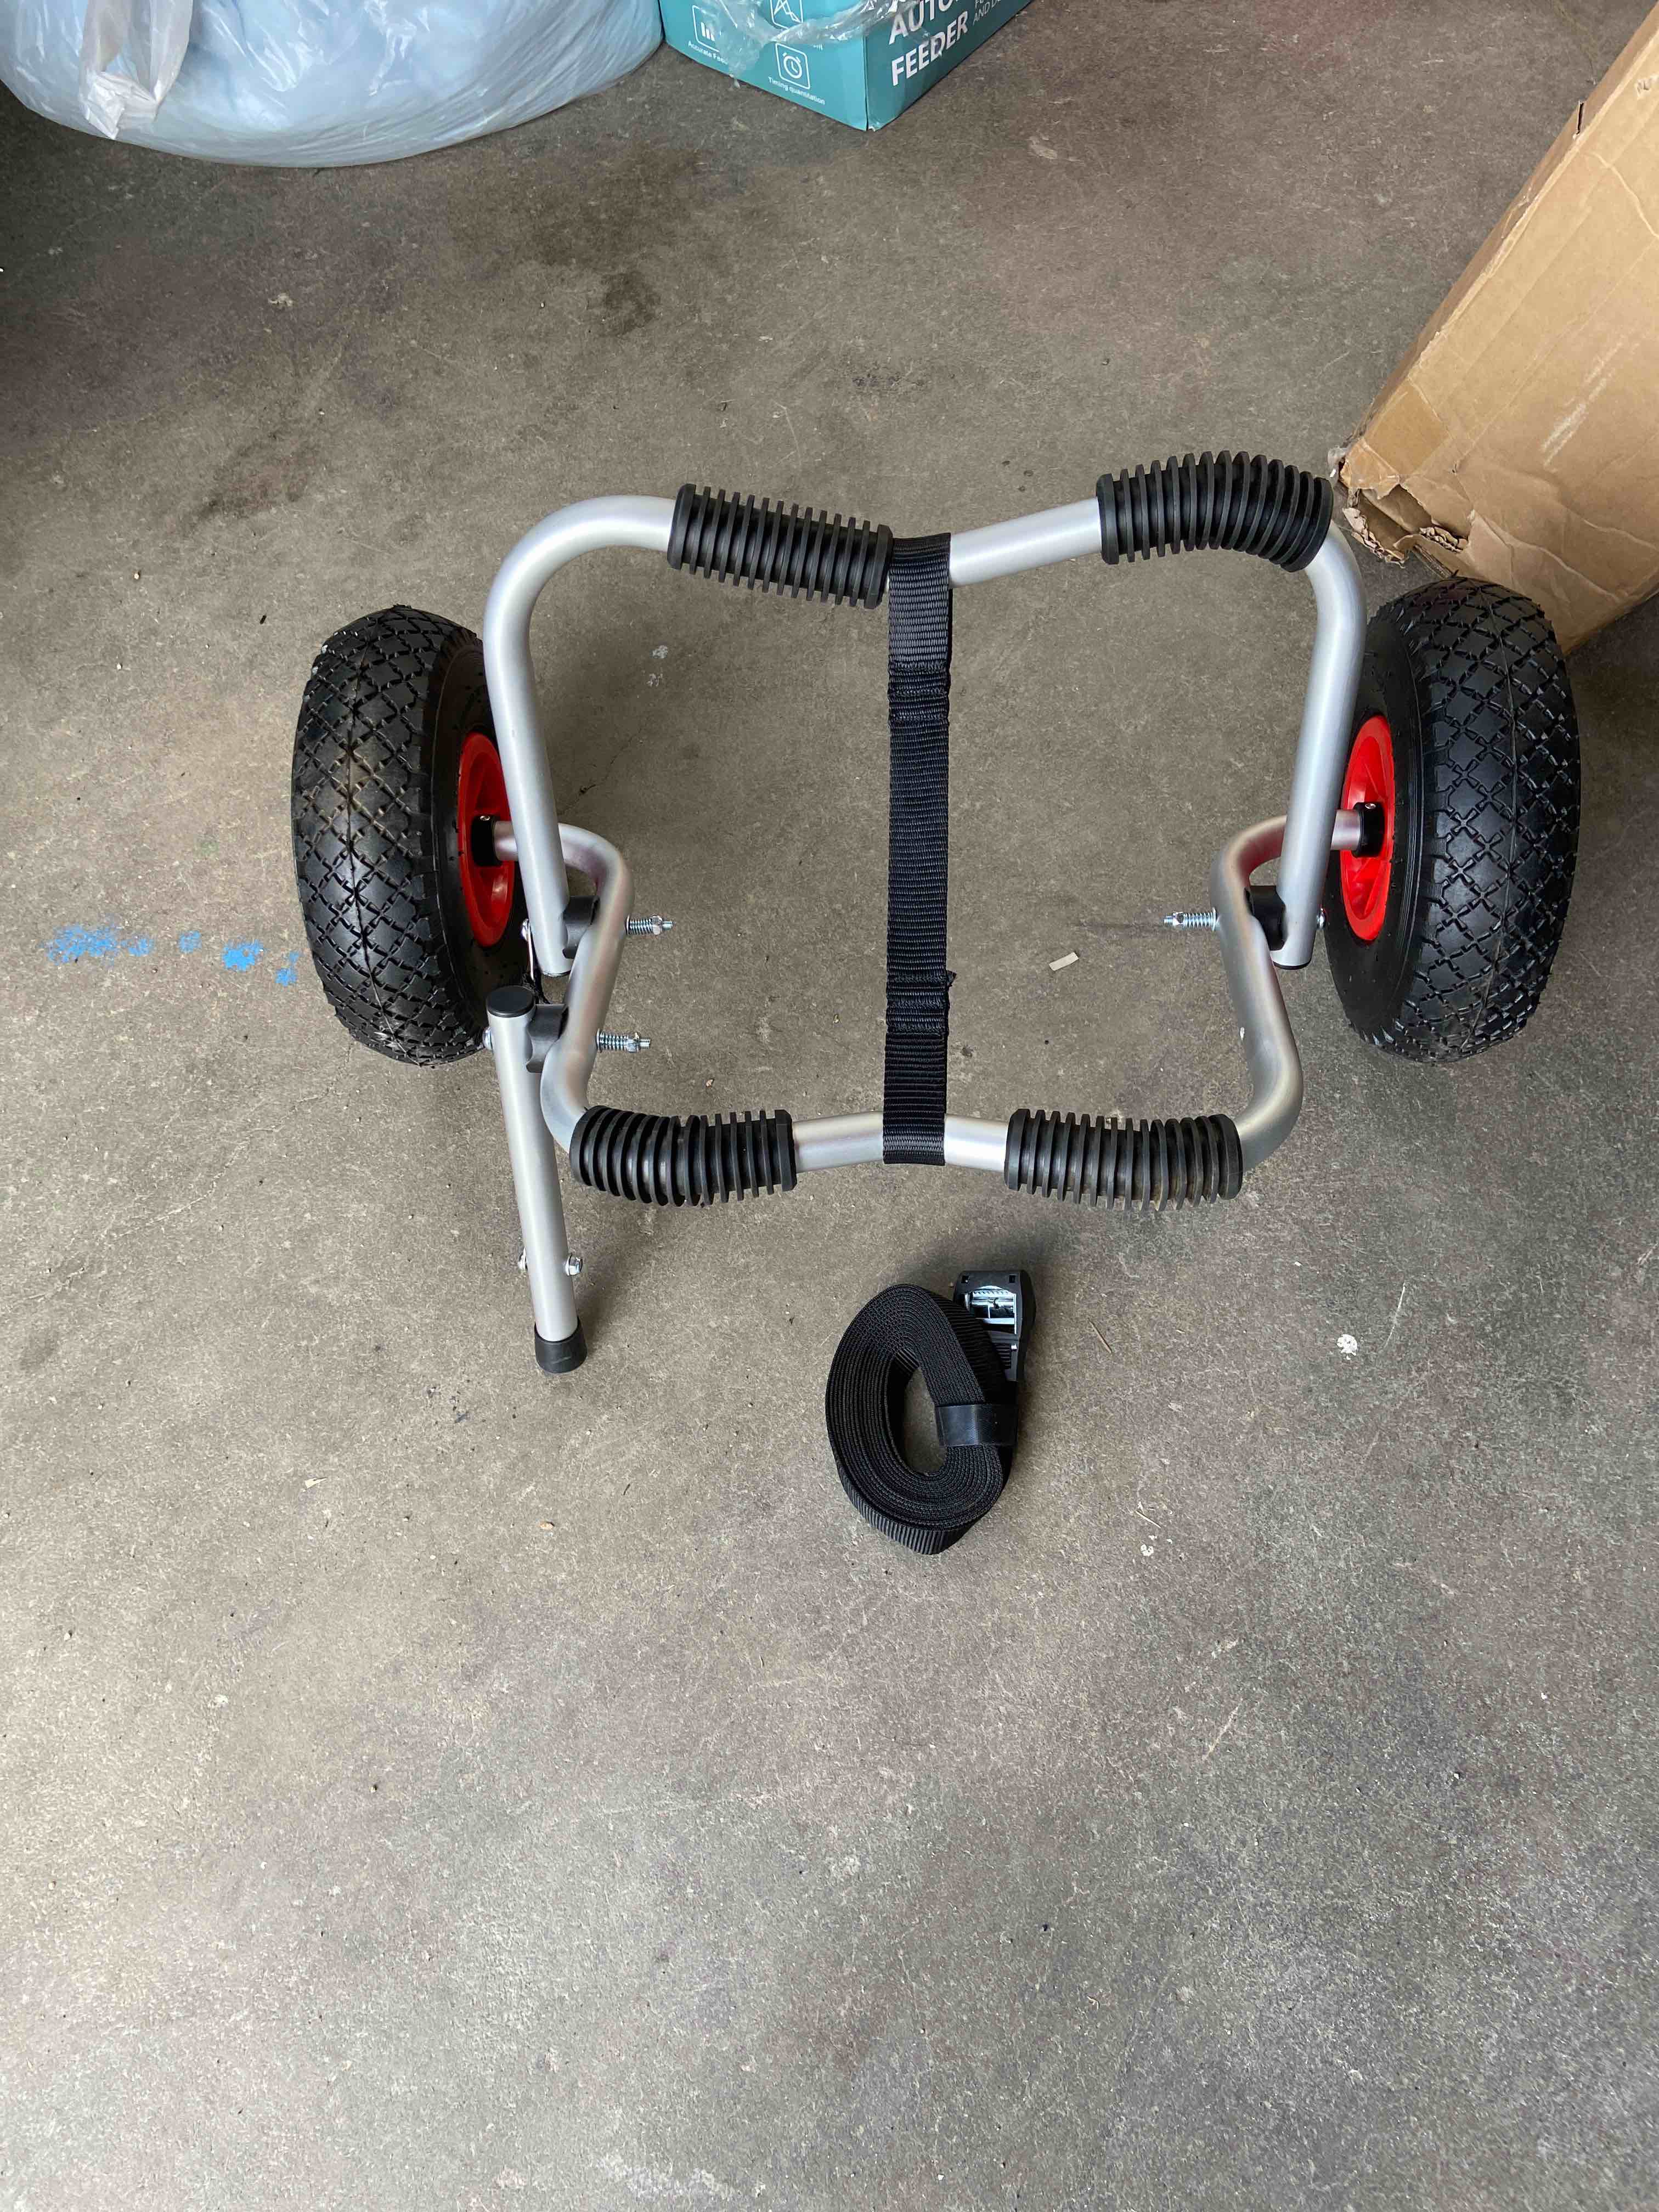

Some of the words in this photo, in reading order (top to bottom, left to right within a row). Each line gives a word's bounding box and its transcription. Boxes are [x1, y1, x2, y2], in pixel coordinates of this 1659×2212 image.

[888, 0, 958, 44] AUTO
[891, 10, 968, 86] FEEDER
[768, 76, 788, 92] Timing
